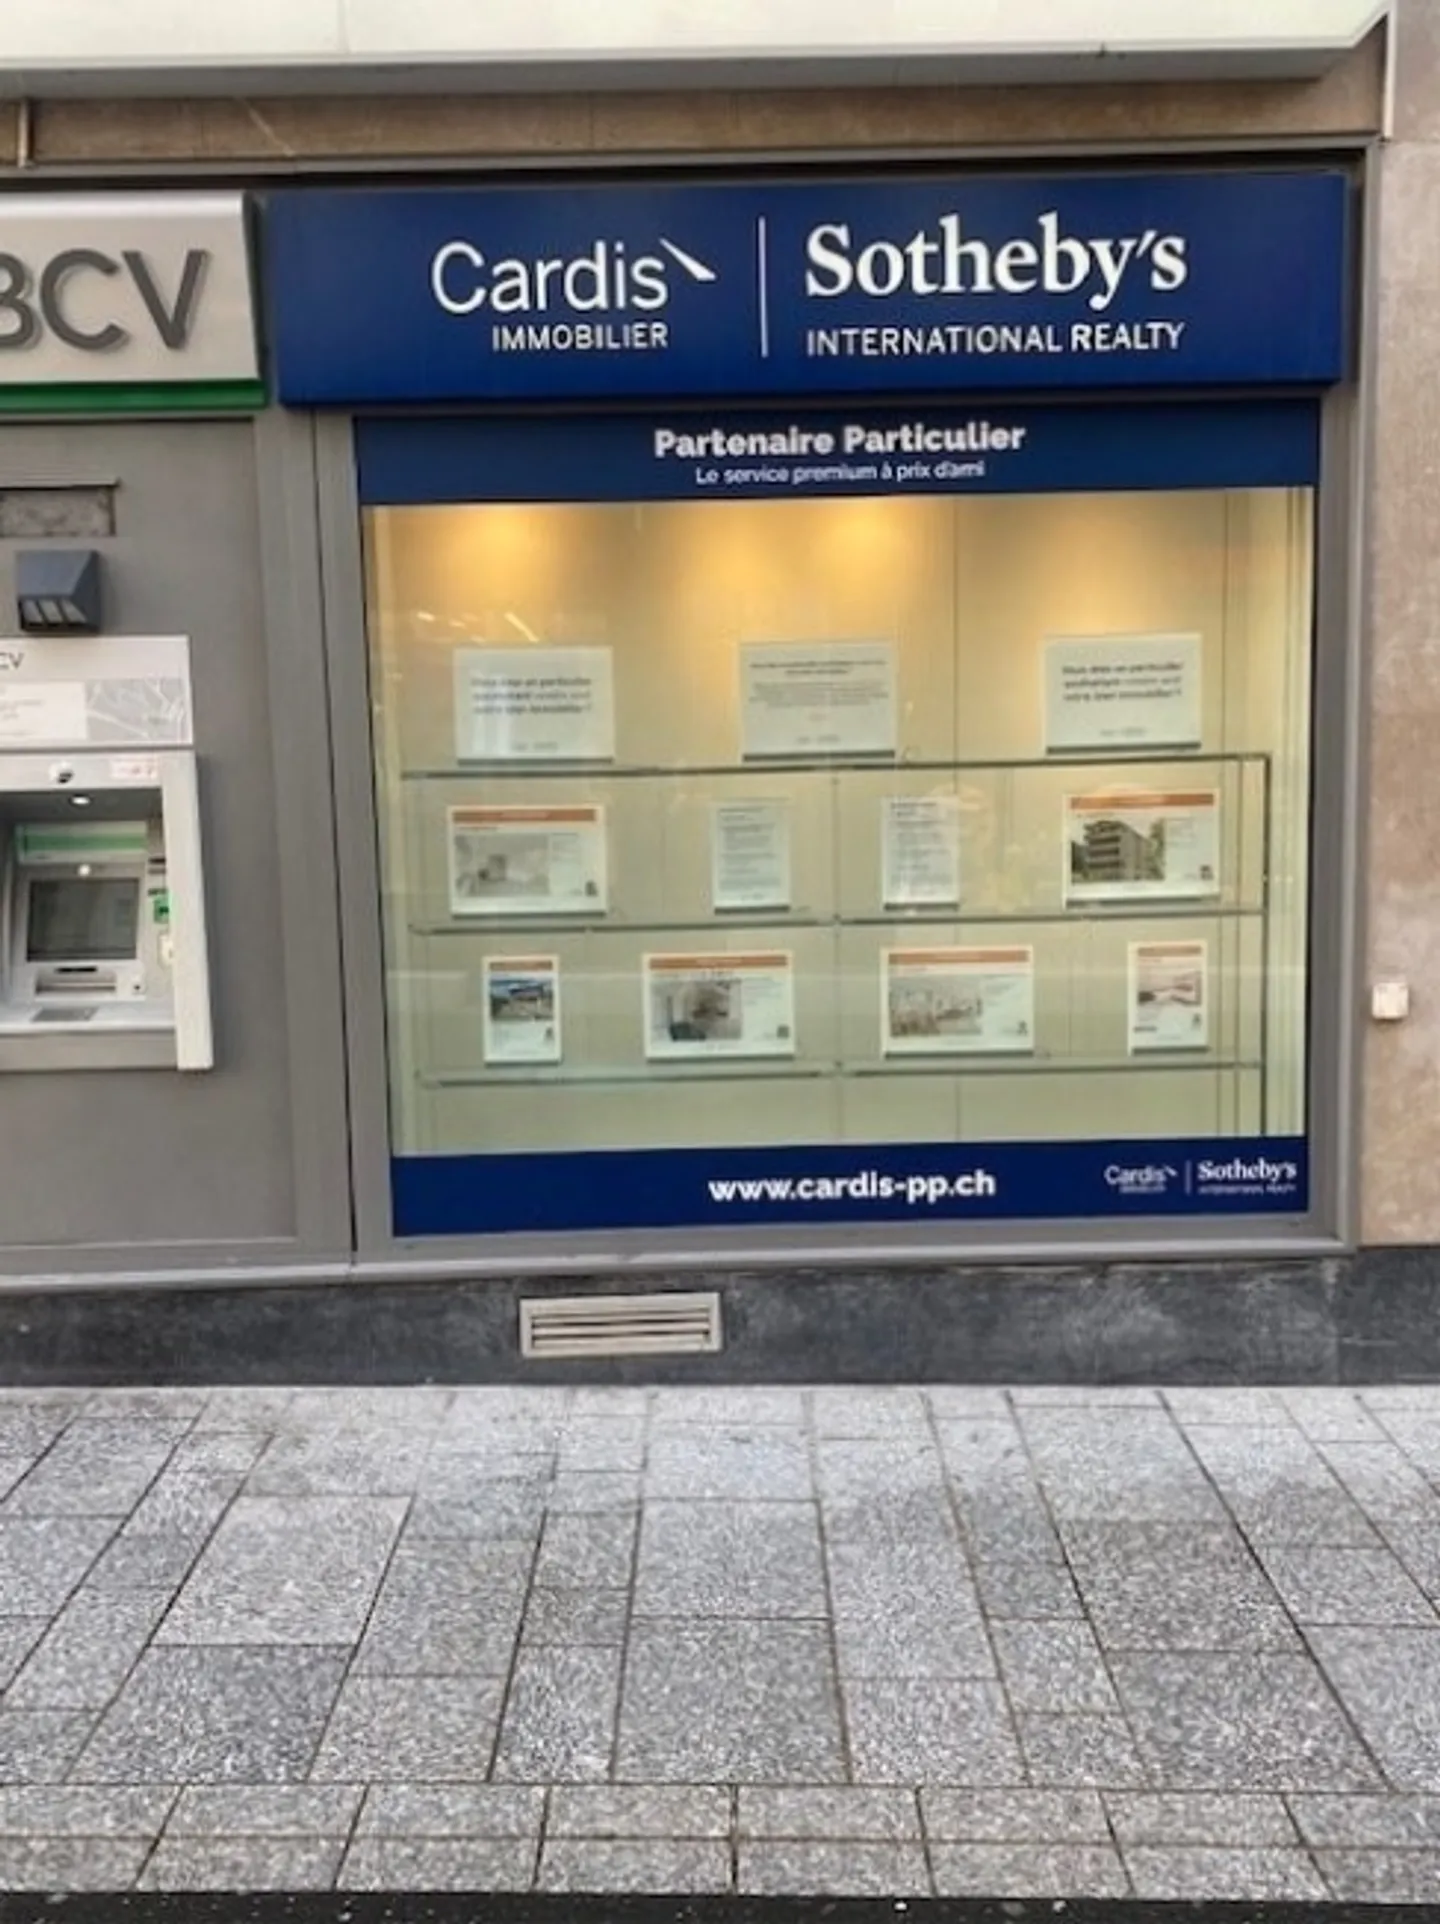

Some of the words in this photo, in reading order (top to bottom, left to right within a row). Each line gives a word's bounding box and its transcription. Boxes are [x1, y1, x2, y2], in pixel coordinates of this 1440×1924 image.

[431, 240, 669, 314] Cardis
[806, 211, 1188, 311] Sotheby's
[0, 248, 207, 352] BCV
[492, 321, 668, 351] IMMOBILIER
[806, 324, 1063, 357] INTERNATIONAL
[1070, 321, 1186, 352] REALTY
[653, 426, 835, 458] Partenaire
[842, 421, 1027, 454] Particulier
[695, 466, 720, 485] Le
[723, 464, 789, 485] service
[791, 462, 878, 485] premium
[896, 459, 932, 483] prix
[707, 1168, 997, 1205] www.cardis-pp.ch
[1198, 1157, 1298, 1183] Sotheby's
